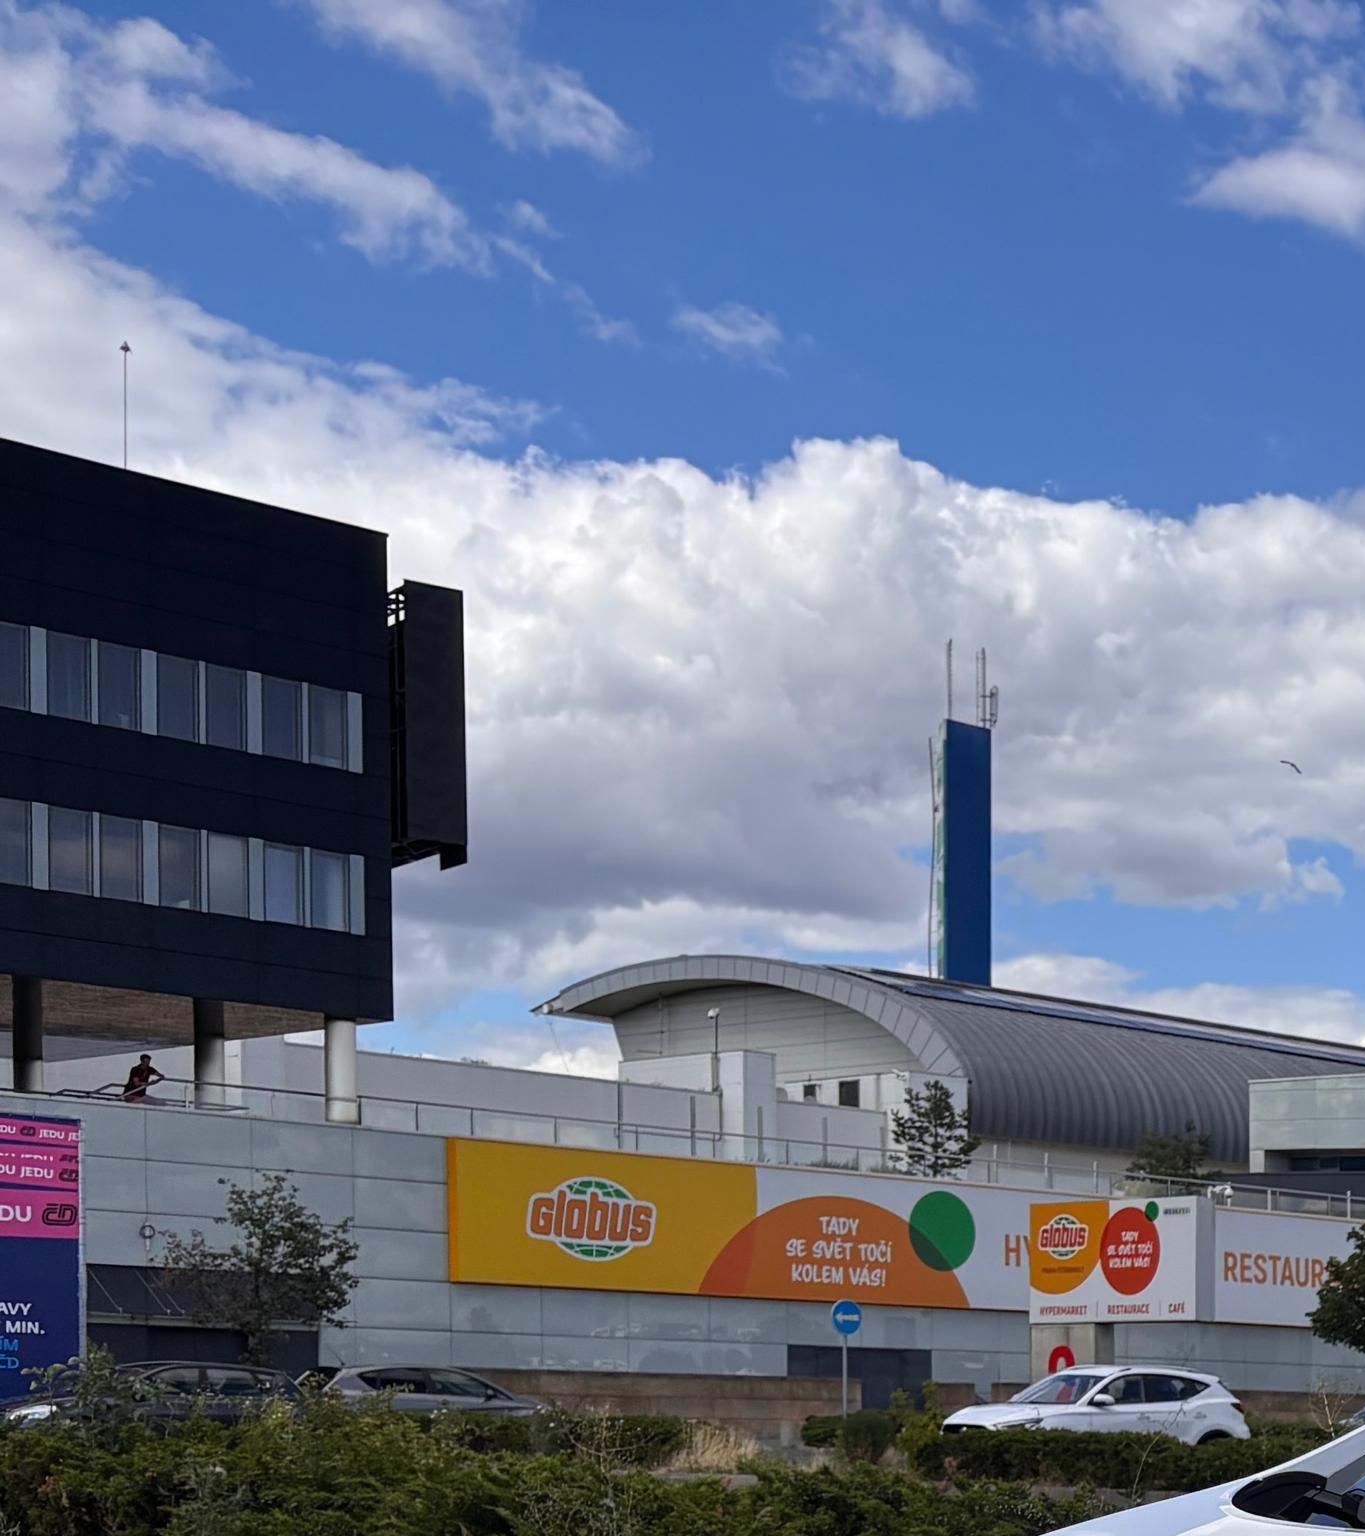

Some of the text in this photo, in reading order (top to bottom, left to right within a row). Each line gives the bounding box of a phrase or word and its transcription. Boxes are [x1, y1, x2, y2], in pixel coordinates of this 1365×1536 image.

[39, 1128, 65, 1140] JEDU
[20, 1166, 54, 1179] JEDU
[530, 1188, 653, 1242] Globus
[819, 1216, 859, 1236] TADY
[1040, 1223, 1087, 1249] Globus
[785, 1237, 893, 1263] SE SVĚT TOČÍ
[791, 1263, 886, 1287] KOLEM VÁS!
[1223, 1251, 1341, 1289] RESTAUR
[1040, 1301, 1185, 1316] HYPERMARKET RESTAURACE CAFÉ
[6, 1320, 46, 1335] MIN.
